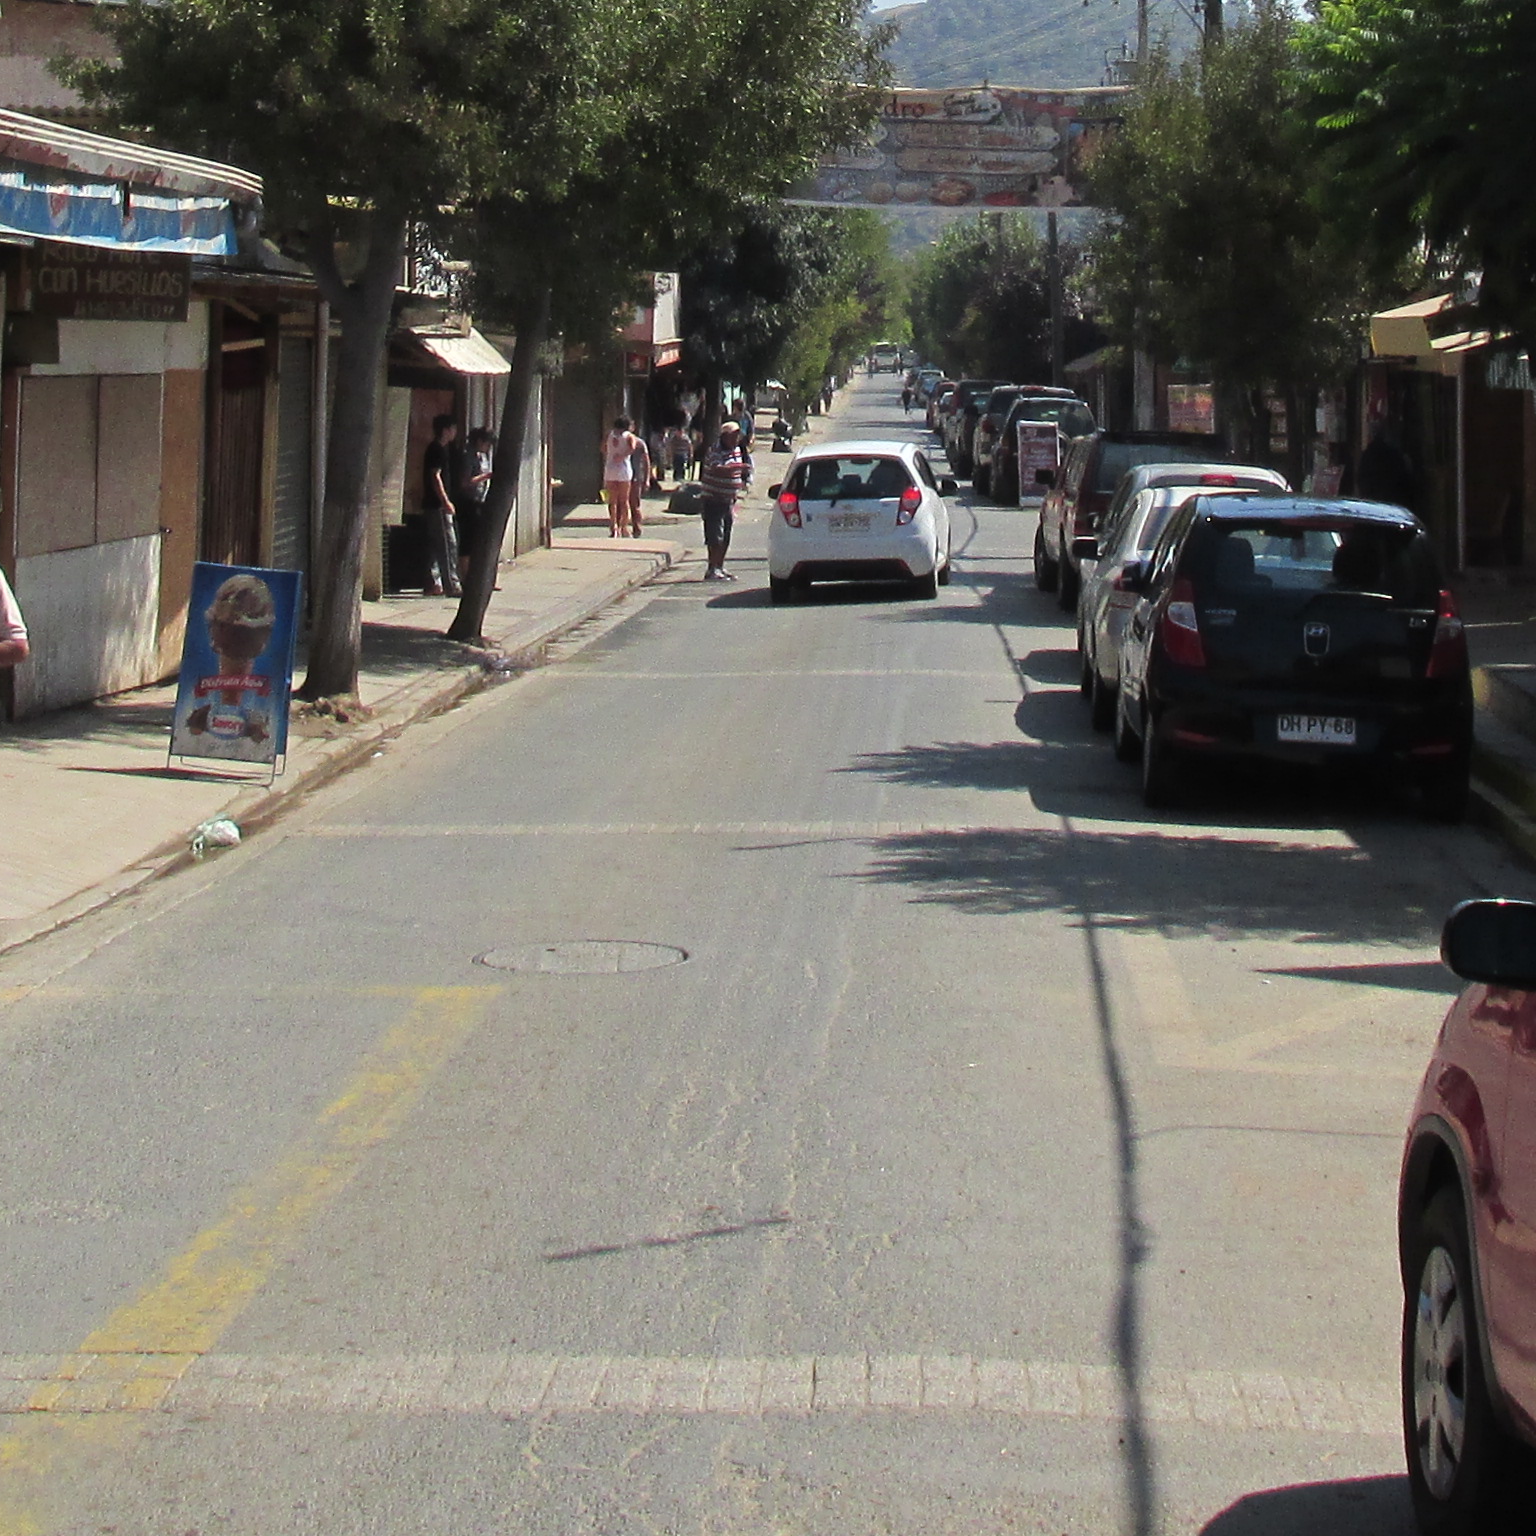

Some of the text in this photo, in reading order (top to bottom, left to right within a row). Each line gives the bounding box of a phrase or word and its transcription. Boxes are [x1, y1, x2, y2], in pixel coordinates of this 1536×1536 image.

[883, 93, 926, 118] dro
[1280, 716, 1301, 732] DH
[1307, 717, 1327, 733] PY
